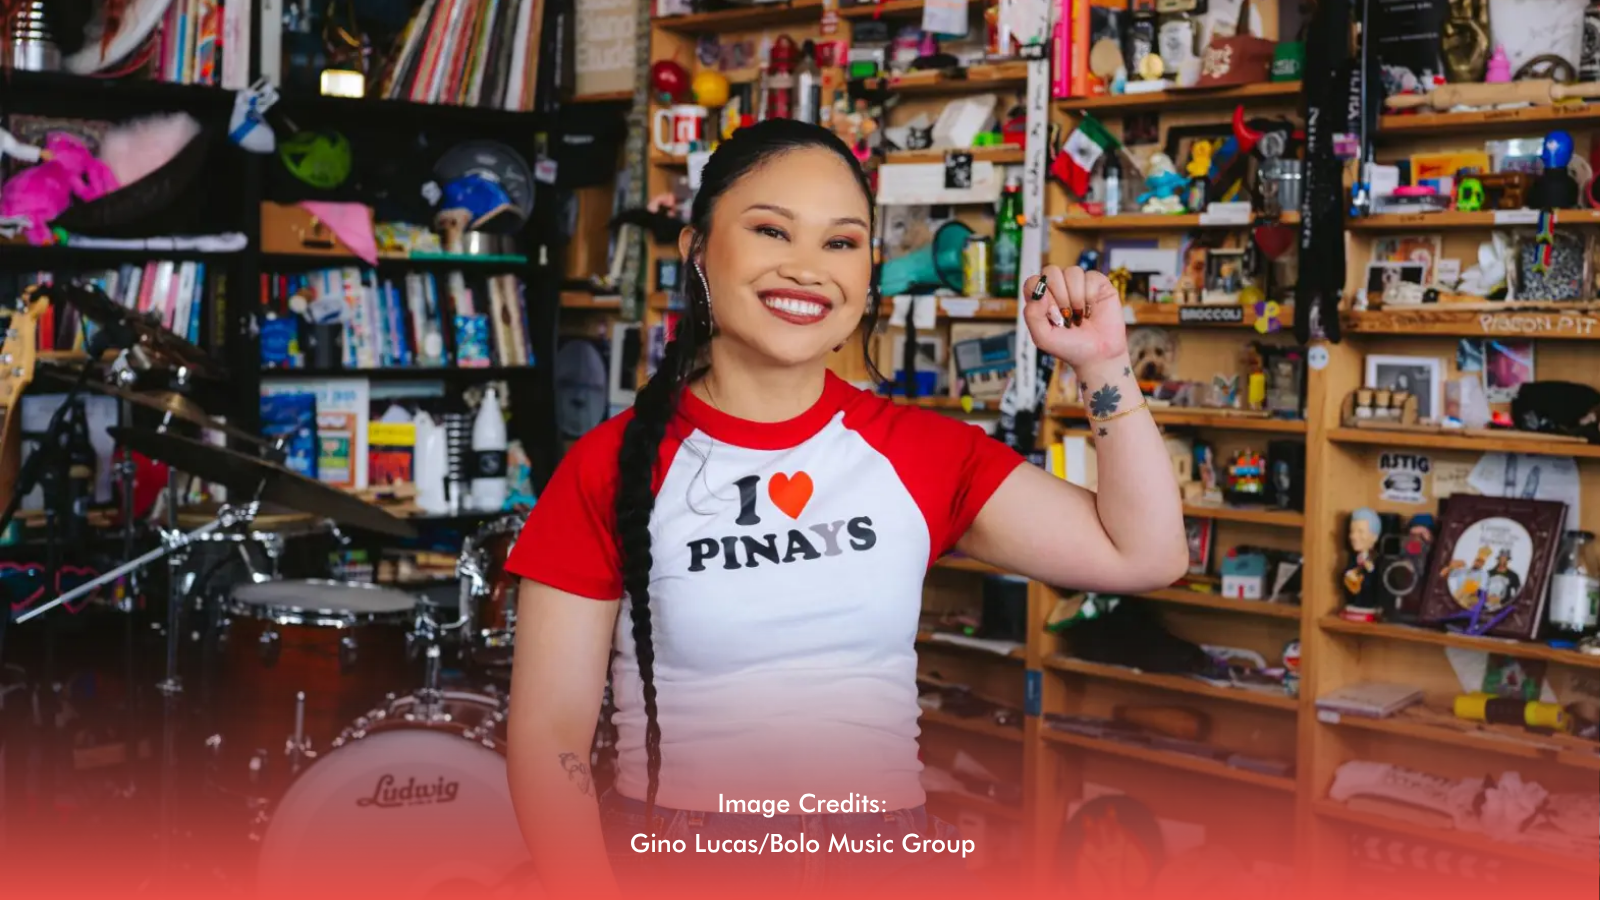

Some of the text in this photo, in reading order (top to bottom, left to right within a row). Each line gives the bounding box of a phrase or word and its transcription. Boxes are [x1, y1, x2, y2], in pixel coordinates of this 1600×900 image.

[1180, 307, 1242, 321] BROCCOLI
[1556, 316, 1598, 335] PIT
[1380, 453, 1429, 473] ASTIG
[733, 475, 761, 526] I
[686, 516, 877, 572] PINAYS
[356, 774, 459, 808] Ludwig
